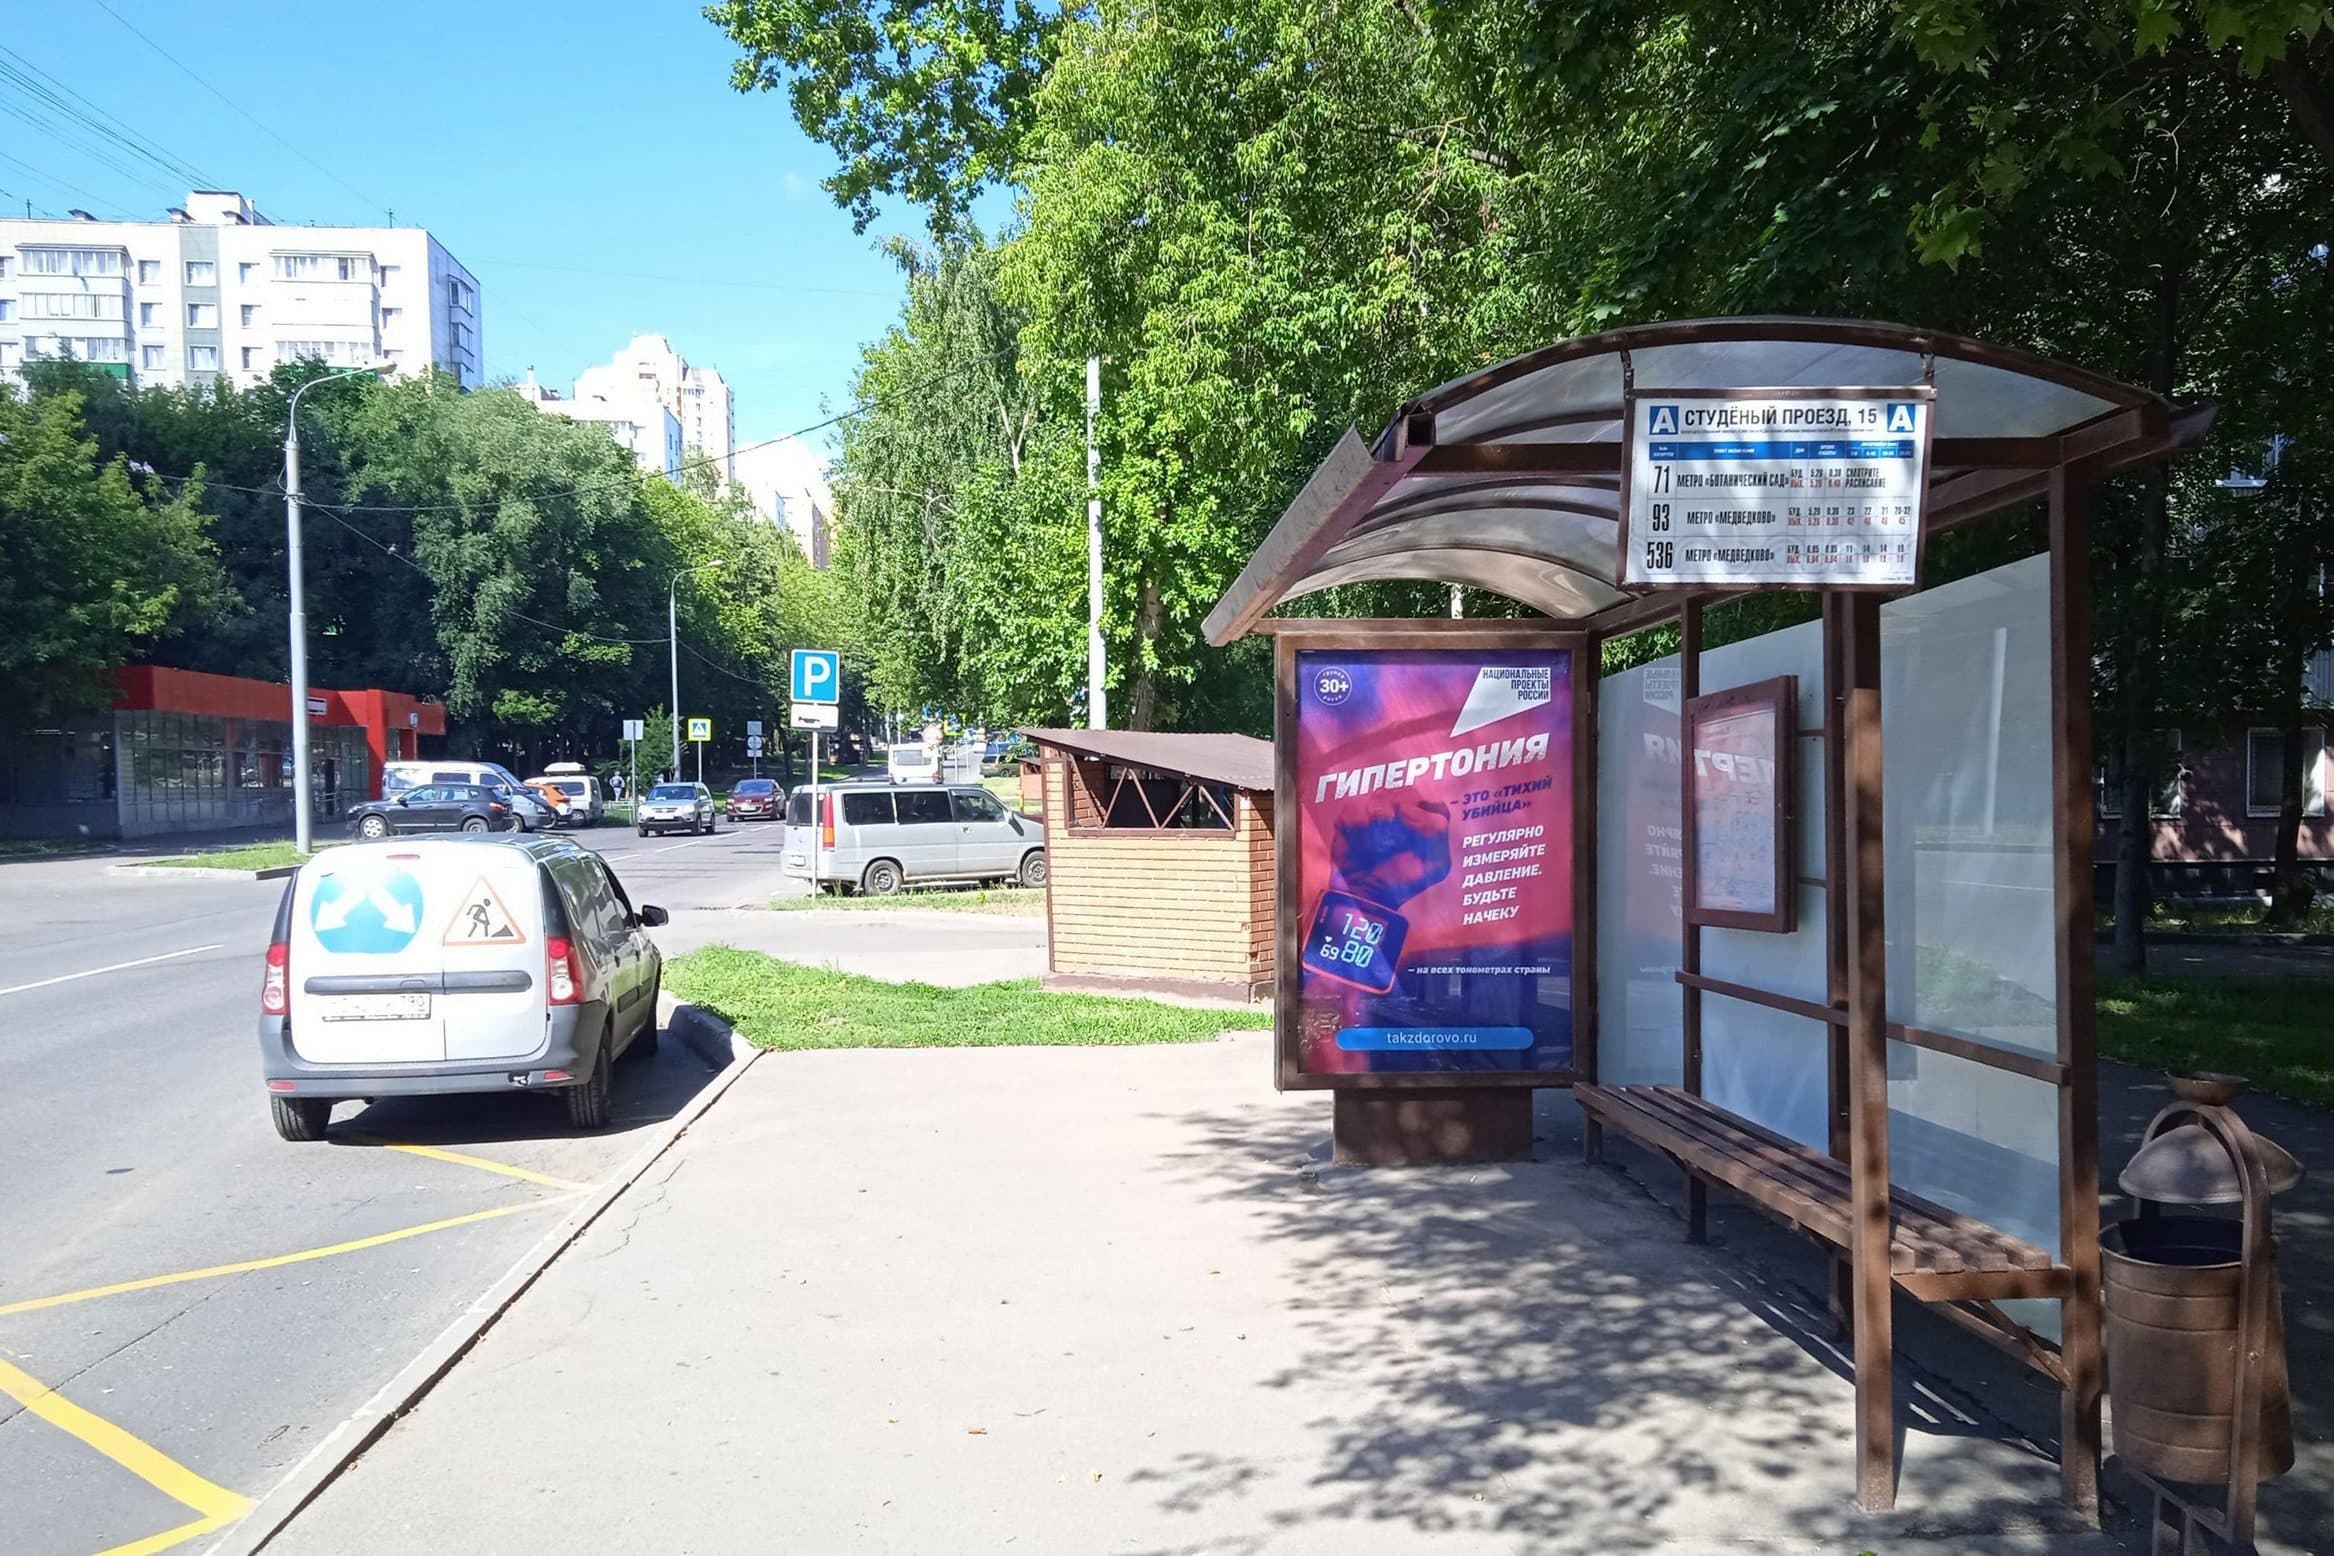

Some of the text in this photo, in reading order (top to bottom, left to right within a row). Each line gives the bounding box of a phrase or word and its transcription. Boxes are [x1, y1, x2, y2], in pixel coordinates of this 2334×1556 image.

[1651, 407, 1677, 433] А
[1684, 405, 1877, 427] СТУДЁНЫЙ ПРОЕЗД, 15
[1888, 404, 1914, 432] А
[1653, 465, 1670, 494] 71
[1677, 472, 1789, 488] МЕТРО «БОТАНИЧЕСКИЙ САД»
[1652, 504, 1670, 531] 93
[1687, 511, 1776, 525] МЕТРО «МЕДВЕДКОВО»
[1646, 541, 1673, 569] 536
[1685, 549, 1775, 563] МЕТРО «МЕДВЕДКОВО»
[1482, 669, 1549, 680] НАЦИОНАЛЬНЫЕ
[1511, 679, 1549, 690] ПРОЕКТЫ
[1320, 679, 1349, 693] 30+
[1517, 690, 1549, 700] РОССИИ
[1315, 732, 1550, 803] ГИПЕРТОНИЯ
[1462, 790, 1489, 805] ЭТО
[1494, 776, 1552, 799] «ТИХИЙ
[1462, 800, 1531, 821] УБИЙЦА»
[1463, 825, 1544, 848] РЕГУЛЯРНО
[1463, 844, 1545, 868] ИЗМЕРЯЙТЕ
[1462, 864, 1543, 888] ДАВЛЕНИЕ.
[1463, 887, 1517, 906] БУДЬТЕ
[1463, 906, 1520, 925] НАЧЕКУ
[1342, 912, 1383, 944] 120
[1320, 940, 1374, 968] 69 80
[1416, 966, 1429, 974] на
[1430, 966, 1453, 974] всех
[1455, 965, 1513, 975] тонометрах
[1514, 965, 1551, 975] страны
[1387, 1031, 1477, 1044] takzdorovo.ru
